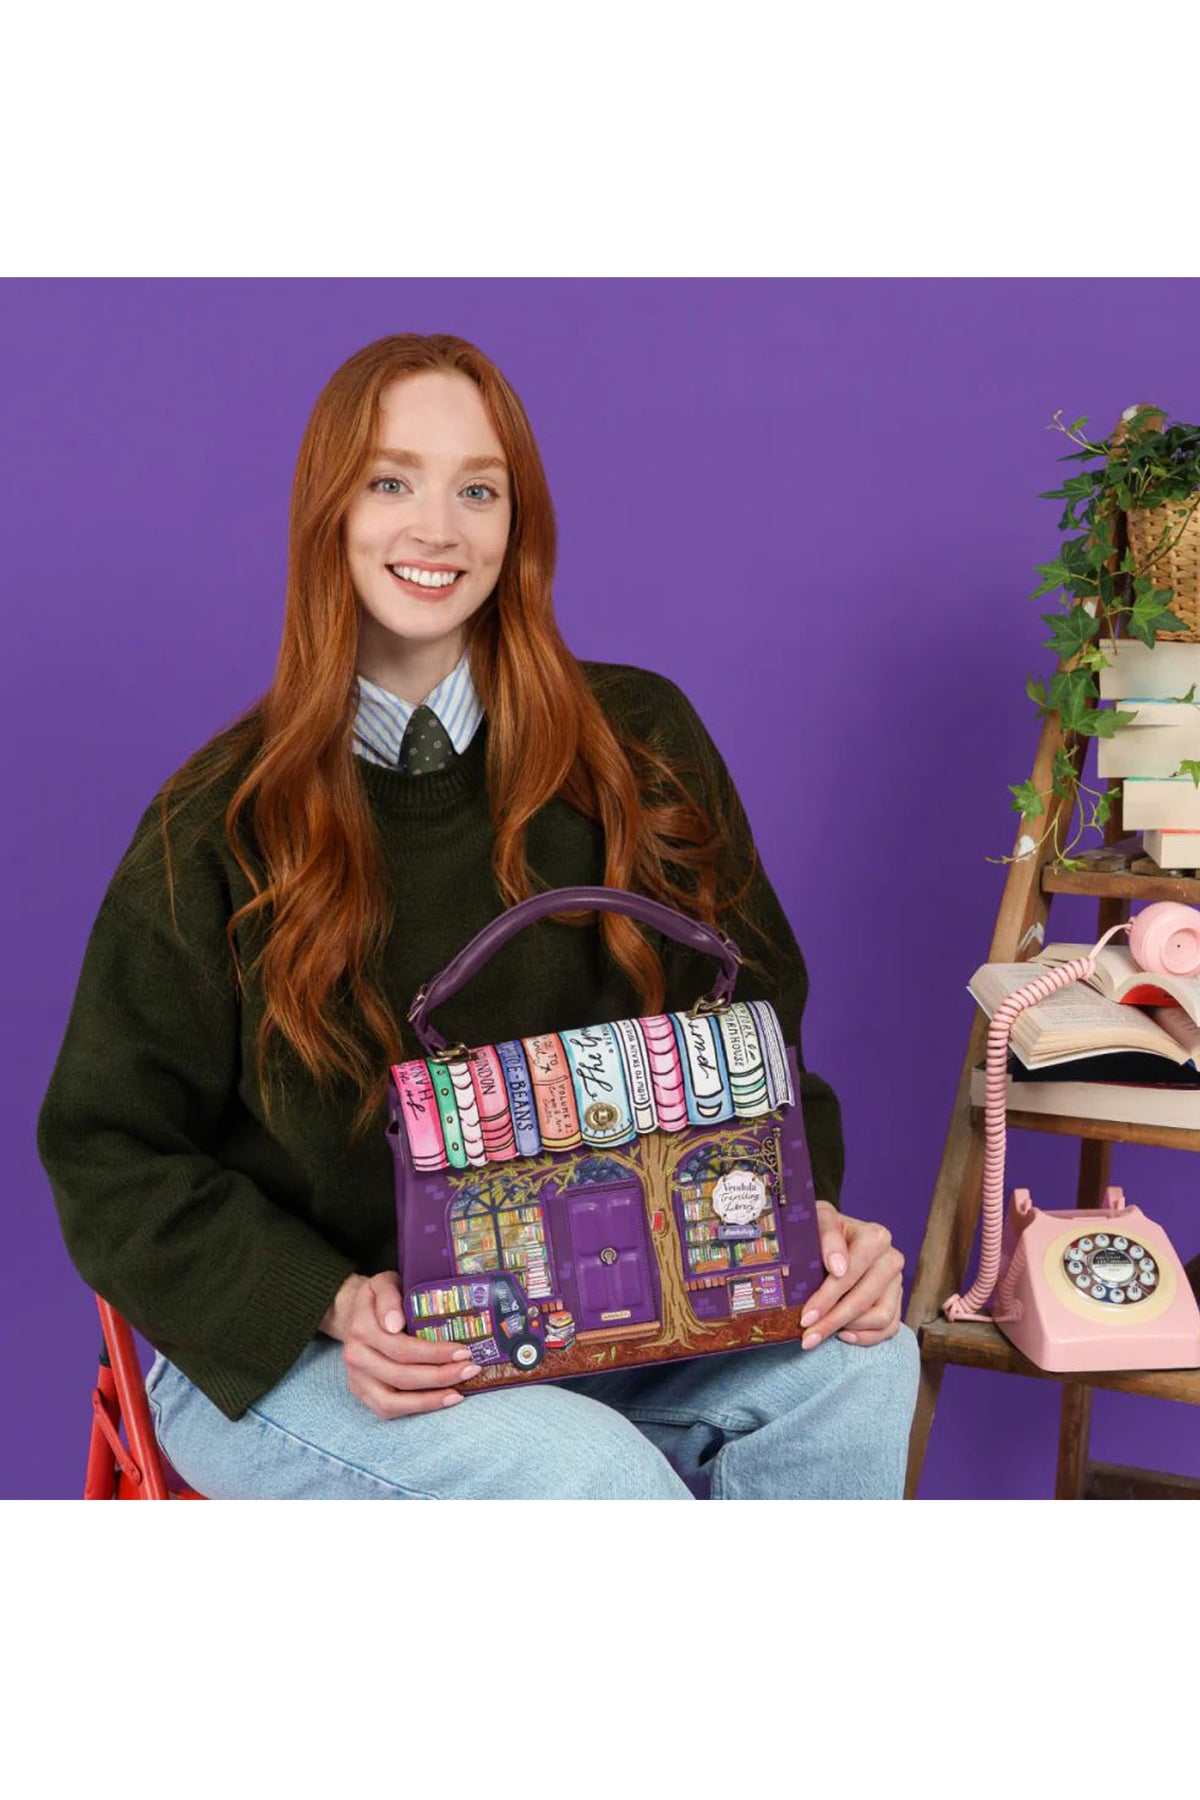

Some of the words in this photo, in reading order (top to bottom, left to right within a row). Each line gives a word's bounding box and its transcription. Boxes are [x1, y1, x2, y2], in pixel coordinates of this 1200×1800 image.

[630, 1045, 642, 1068] TRAIN
[577, 1052, 613, 1101] The
[636, 1070, 643, 1080] TO
[557, 1083, 570, 1119] VOLUME
[638, 1082, 647, 1101] HOW
[723, 1182, 757, 1191] Vendula
[725, 1201, 754, 1213] Library
